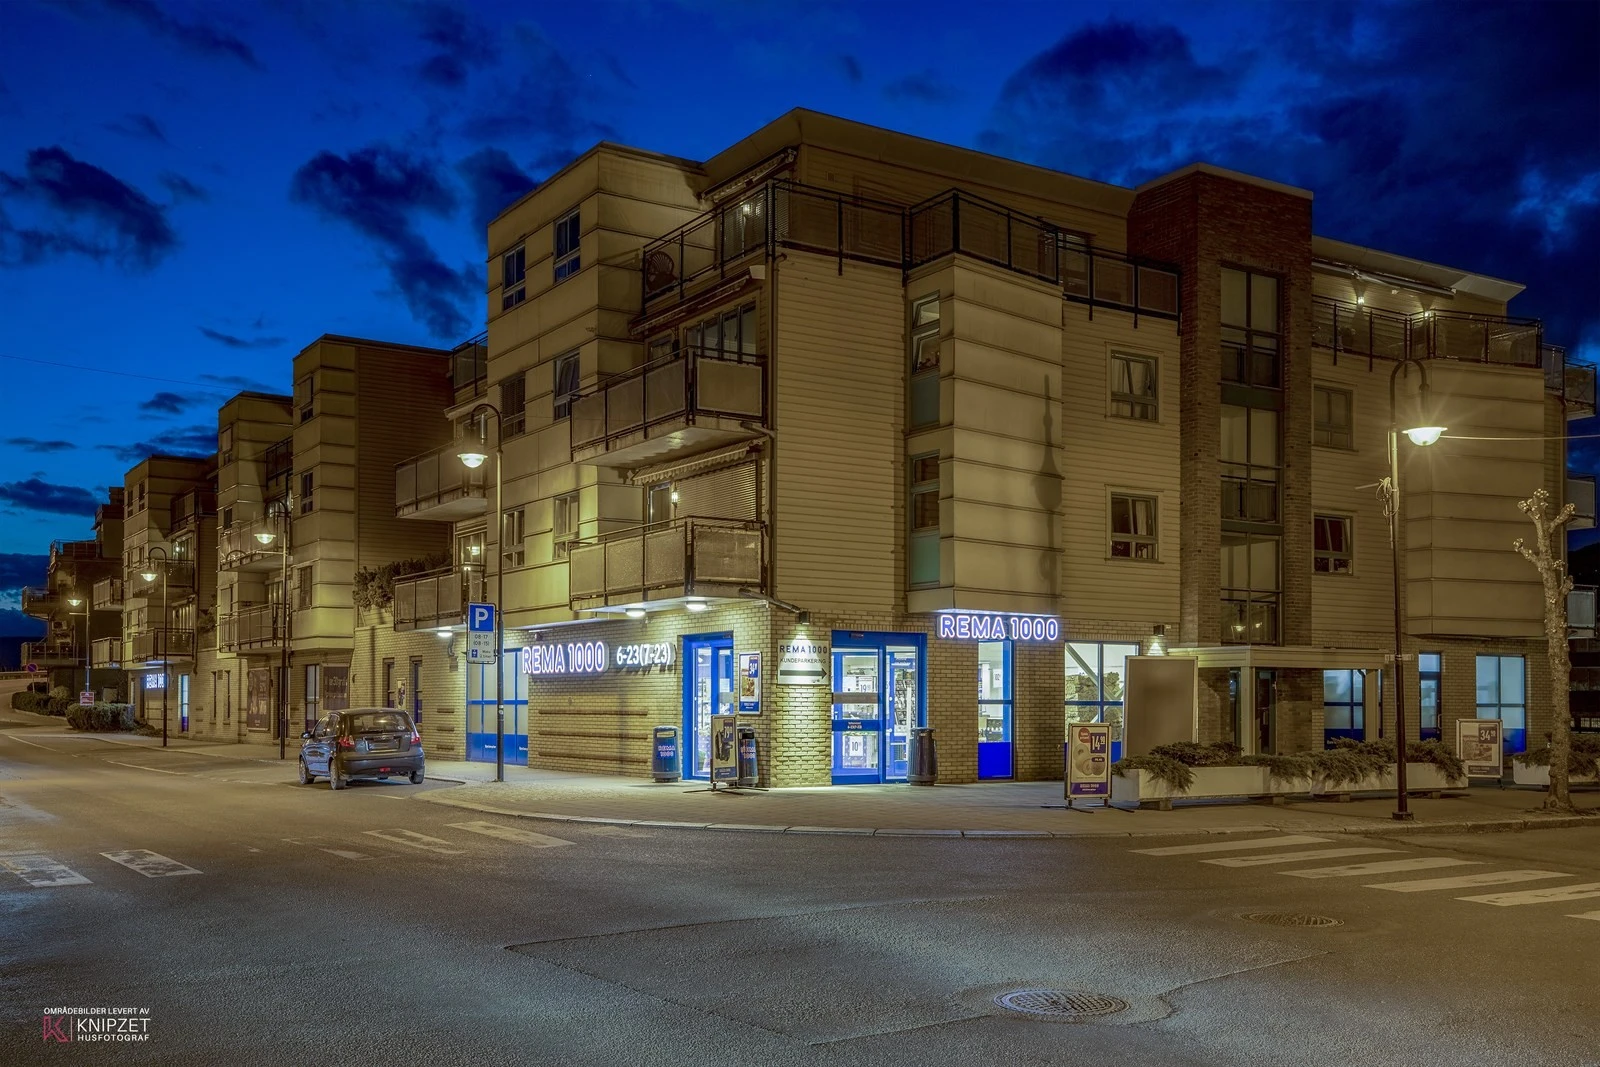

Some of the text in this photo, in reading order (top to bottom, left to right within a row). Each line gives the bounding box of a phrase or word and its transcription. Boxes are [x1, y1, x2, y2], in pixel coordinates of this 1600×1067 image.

[475, 608, 489, 629] P
[940, 614, 1058, 641] REMA 1000
[522, 641, 605, 674] REMA 1000
[616, 641, 671, 666] 6-23(7-23)
[779, 645, 828, 654] REMA 1000
[1091, 736, 1100, 751] 14
[1480, 730, 1491, 741] 34
